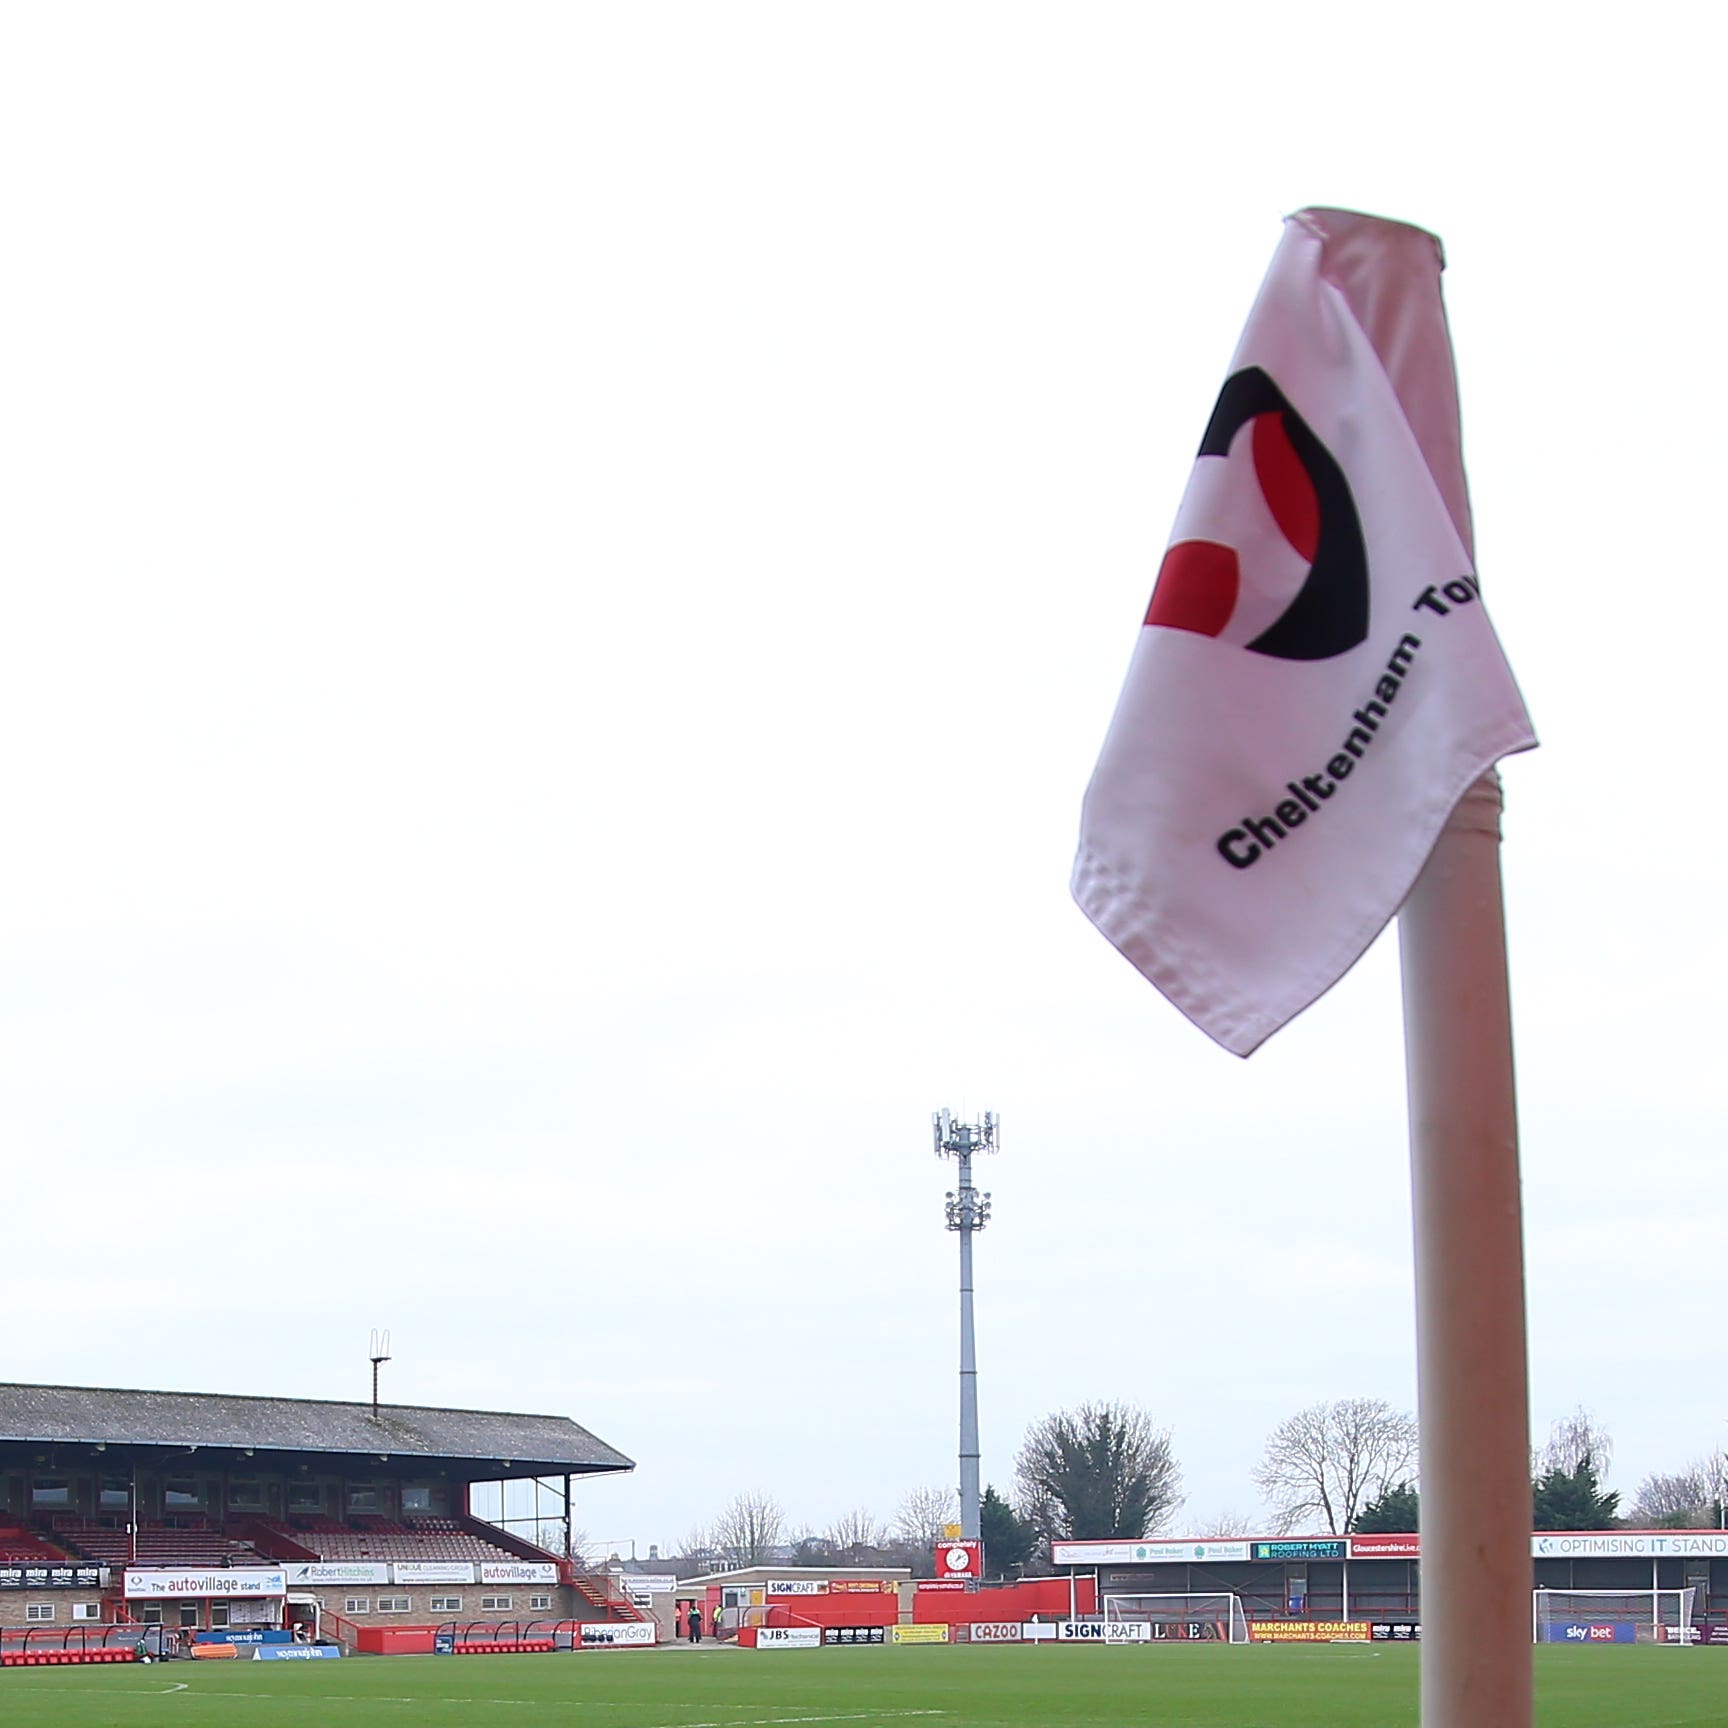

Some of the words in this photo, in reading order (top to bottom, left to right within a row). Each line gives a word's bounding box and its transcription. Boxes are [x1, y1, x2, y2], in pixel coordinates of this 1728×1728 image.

[1216, 632, 1421, 869] Cheltenham
[1560, 1539, 1645, 1553] OPTIMISING
[1651, 1539, 1667, 1552] IT
[1672, 1538, 1727, 1552] STAND
[1272, 1550, 1318, 1558] ROOFING
[483, 1566, 537, 1580] autovillage
[152, 1582, 165, 1592] The
[168, 1577, 239, 1593] autovillage
[241, 1581, 261, 1590] stand
[771, 1583, 814, 1593] SIGNCRAFT
[974, 1625, 1018, 1639] CAZOO
[1065, 1623, 1142, 1638] SIGNCRAFT
[1252, 1622, 1315, 1632] MARCHANTS
[1317, 1622, 1368, 1632] COACHES
[1566, 1625, 1589, 1640] sky
[1590, 1625, 1612, 1639] bet
[769, 1629, 789, 1641] JBS
